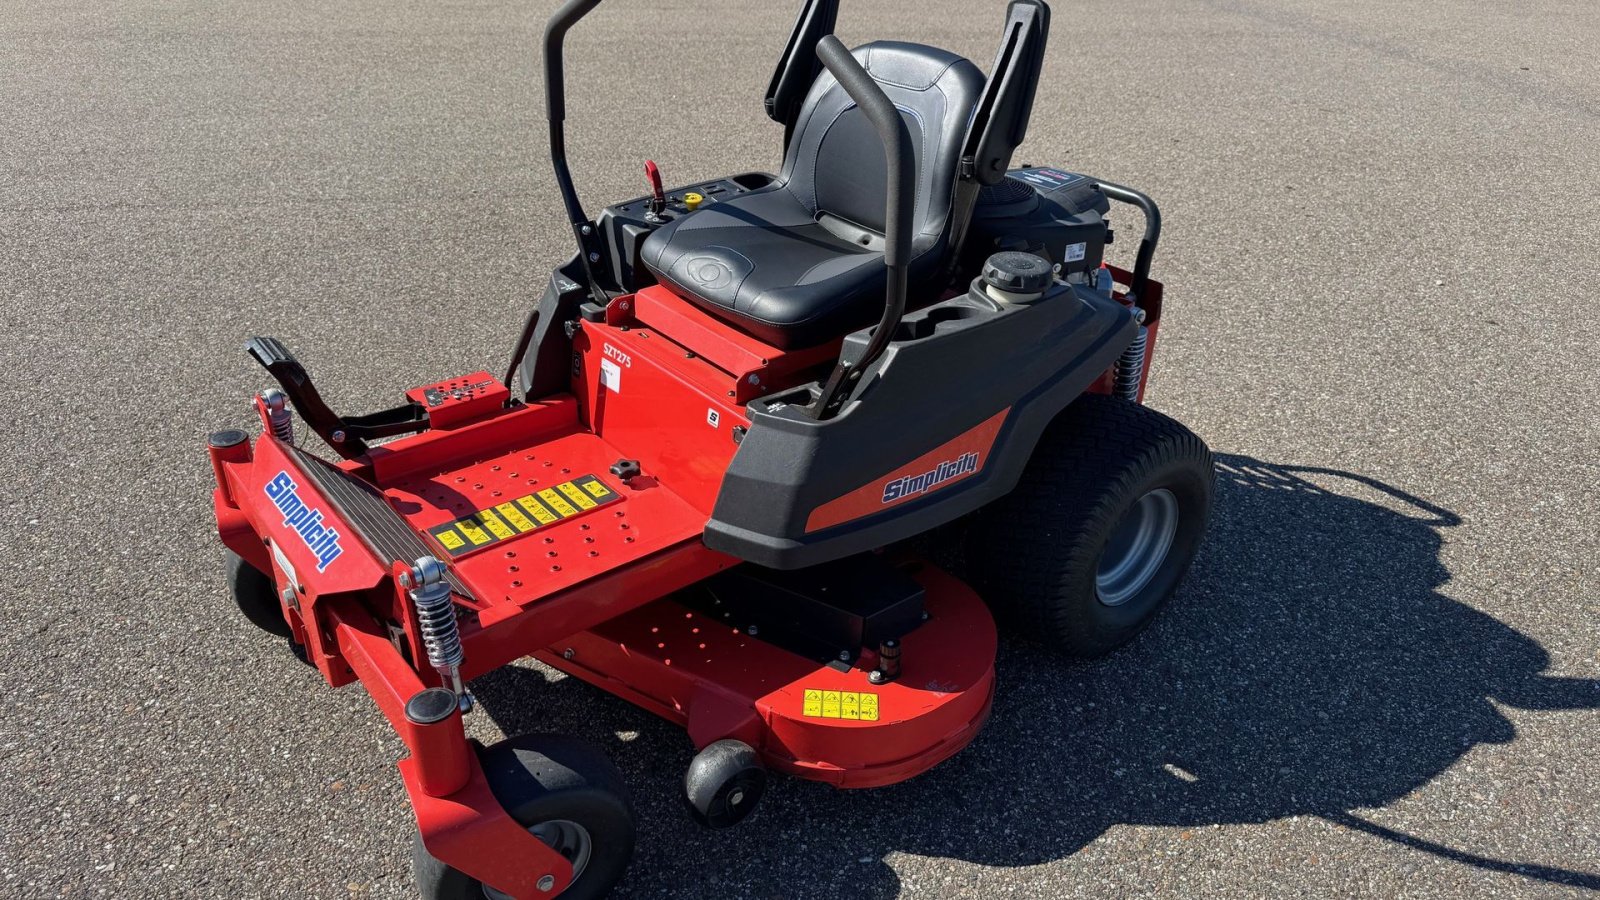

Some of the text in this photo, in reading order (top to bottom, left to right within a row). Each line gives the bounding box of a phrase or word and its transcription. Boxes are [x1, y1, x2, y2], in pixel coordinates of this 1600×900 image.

[603, 342, 631, 368] SZT275
[882, 452, 979, 503] Simplicity
[264, 470, 344, 573] Simplicity
